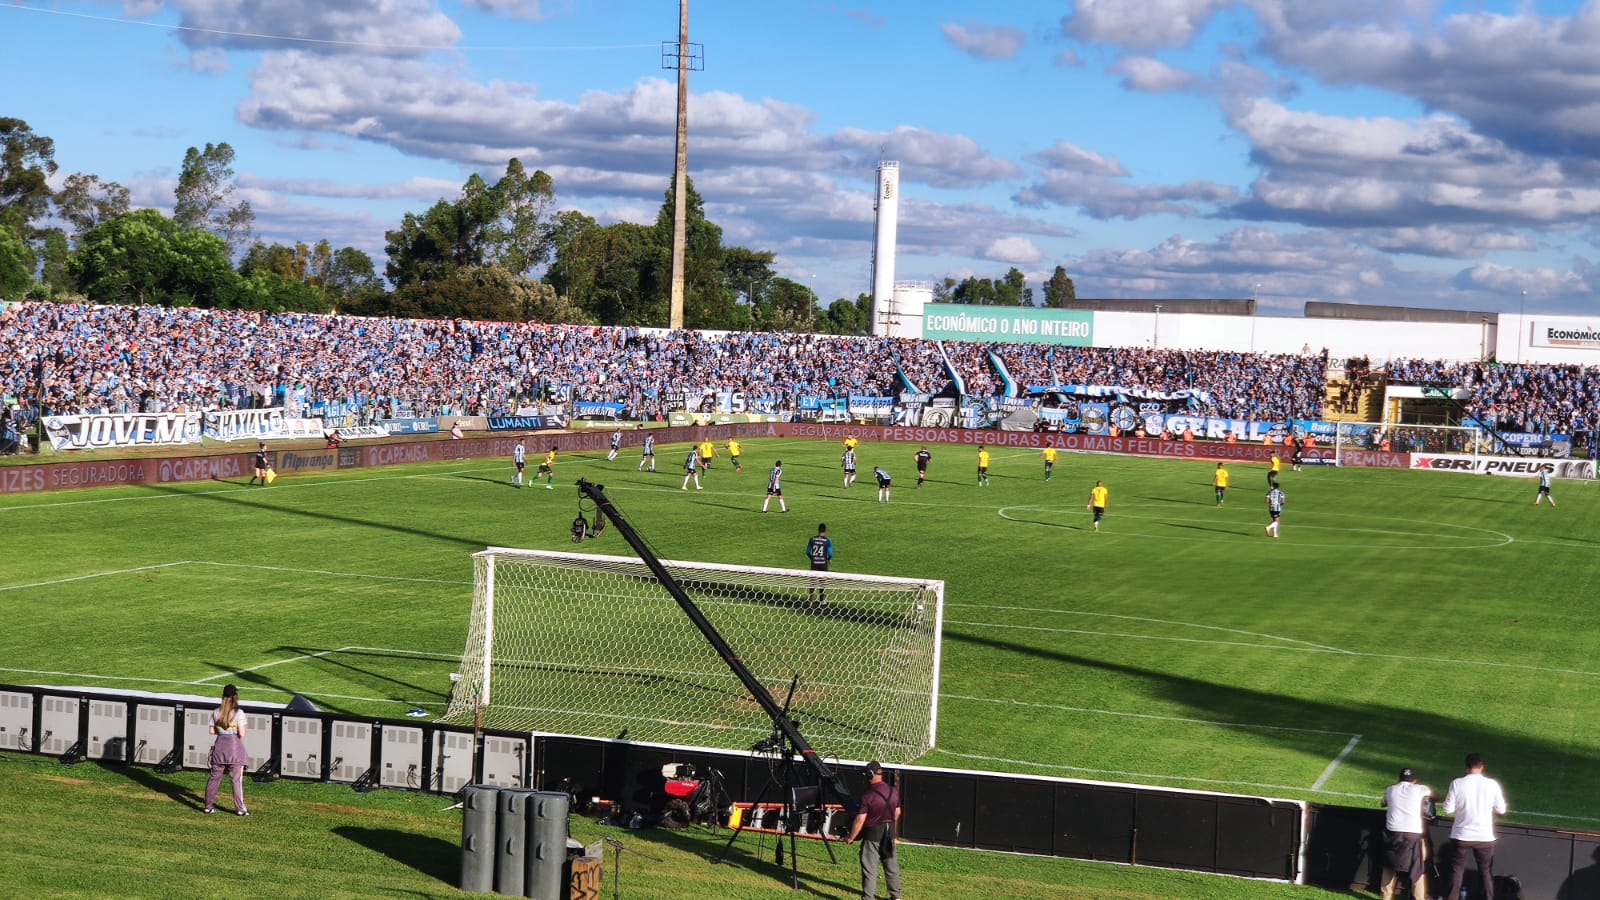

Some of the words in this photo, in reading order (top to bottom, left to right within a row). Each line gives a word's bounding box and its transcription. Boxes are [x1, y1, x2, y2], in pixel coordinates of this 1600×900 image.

[927, 312, 998, 334] ECONÔMICO
[1001, 319, 1009, 333] O
[1013, 319, 1038, 335] ANO
[1041, 320, 1089, 338] INTEIRO
[73, 416, 184, 447] JOVEM
[489, 417, 541, 429] LUMANTI
[792, 425, 878, 439] SEGURADORA
[884, 428, 962, 443] PESSOAS
[964, 431, 1041, 448] SEGURAS
[1046, 432, 1079, 450] SÃO
[1083, 436, 1122, 451] MAIS
[1128, 441, 1195, 457] FELIZES
[1202, 443, 1291, 460] SEGURADORA
[381, 445, 429, 465] CAPEMISA
[173, 459, 240, 480] CAPEMISA
[1485, 461, 1554, 474] PNEUS
[0, 469, 45, 492] IZES
[53, 465, 145, 486] SEGURADORA
[812, 545, 824, 556] 24
